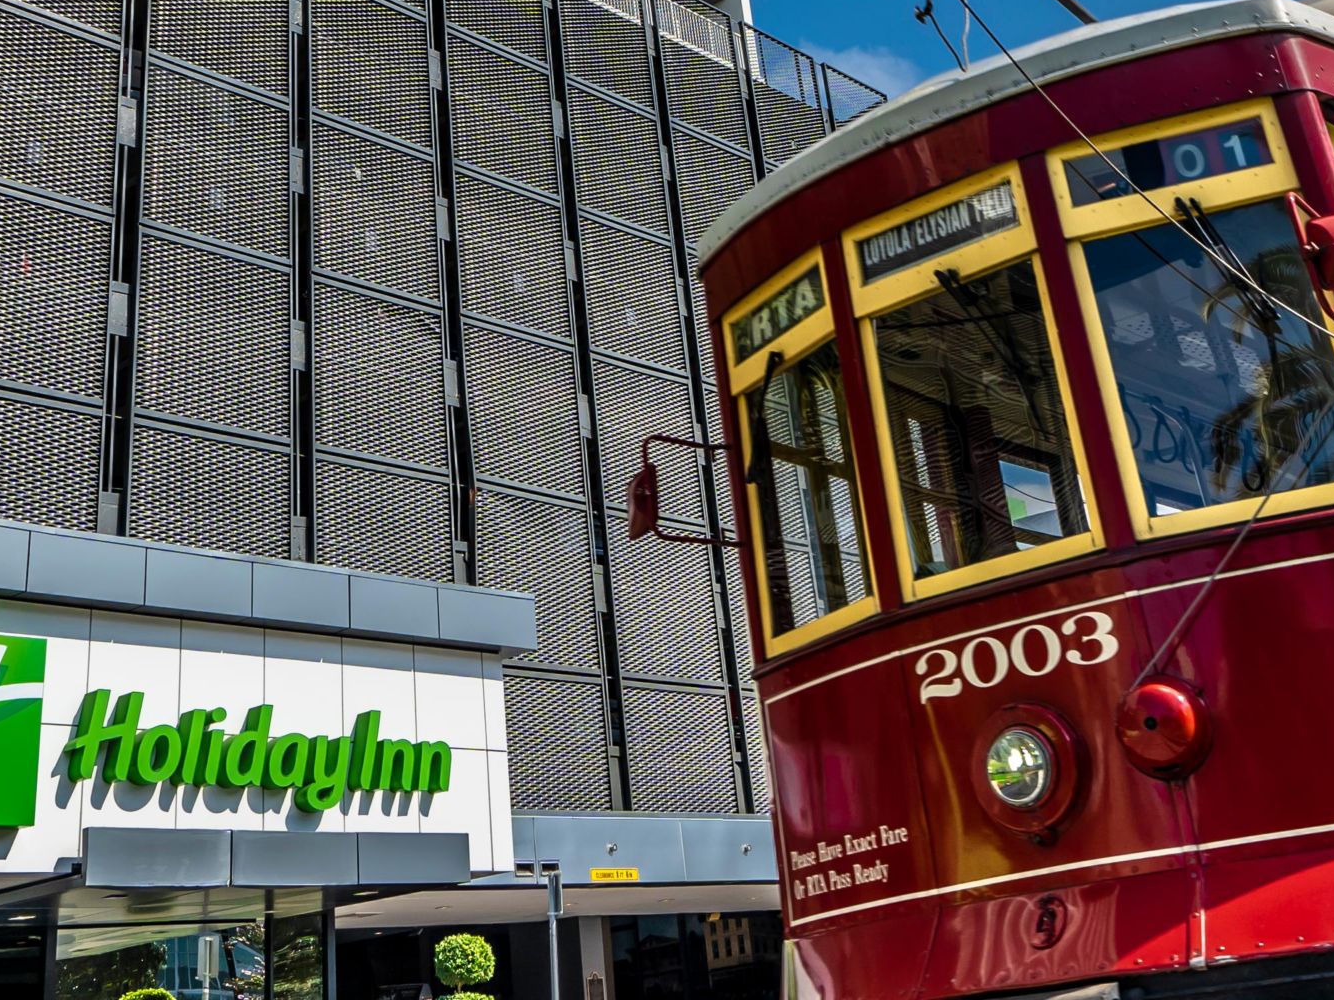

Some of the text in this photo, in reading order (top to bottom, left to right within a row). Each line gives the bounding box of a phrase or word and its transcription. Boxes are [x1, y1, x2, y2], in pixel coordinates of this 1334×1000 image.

[1173, 134, 1248, 178] 01
[863, 225, 912, 265] LOYOLA
[915, 201, 971, 246] ELYSIAN
[750, 278, 817, 347] RTA
[915, 611, 1119, 704] 2003
[64, 688, 453, 813] Holiday Inn
[789, 825, 909, 871] Please Have Exact Fare
[793, 859, 889, 900] Or RTA Pass Ready
